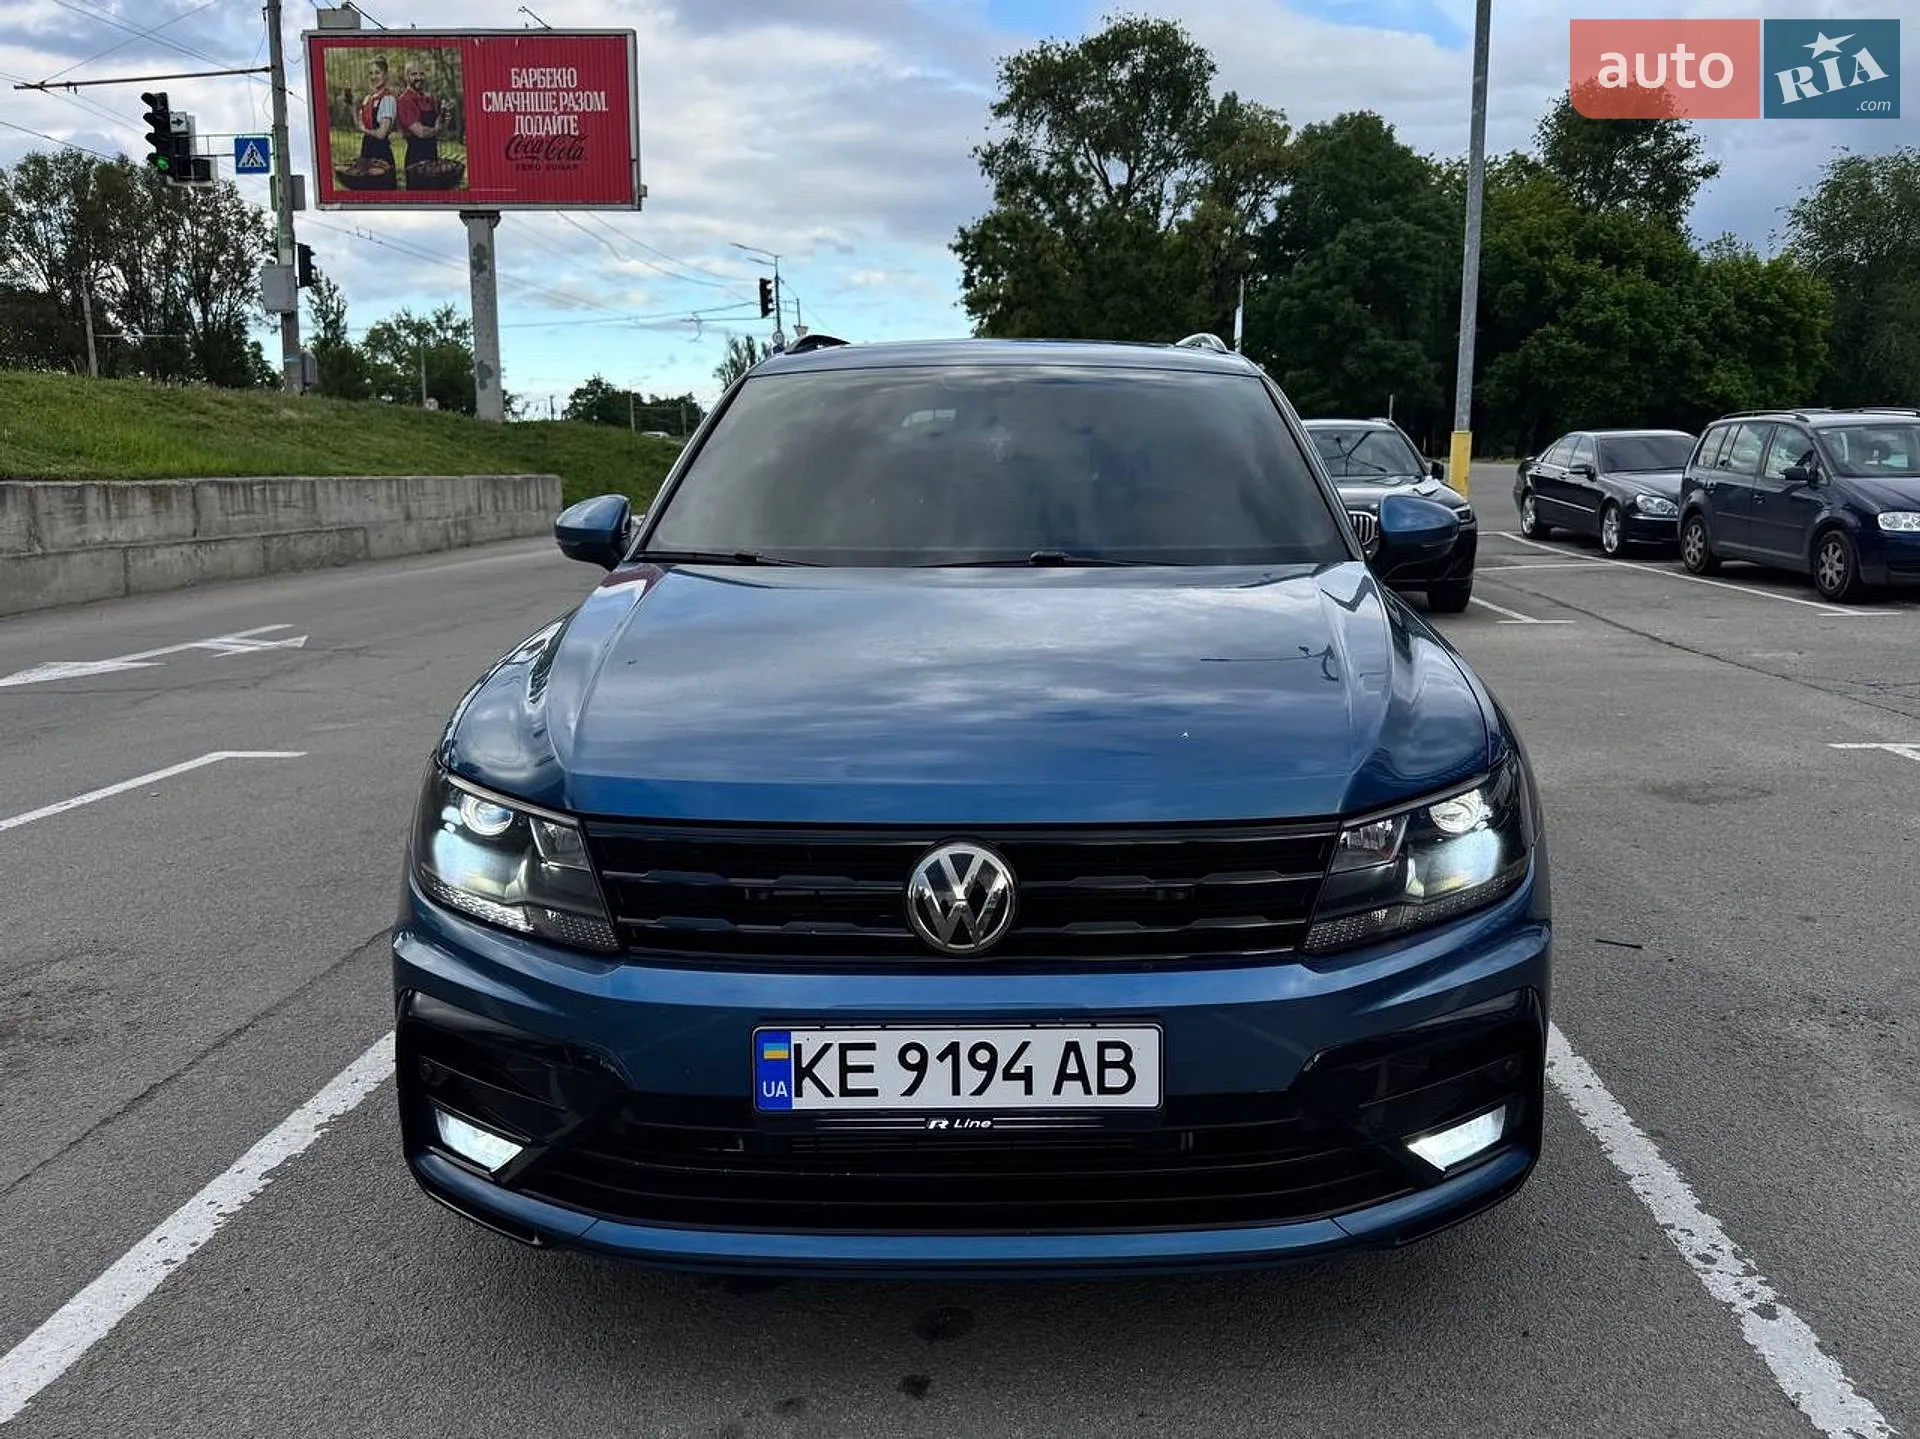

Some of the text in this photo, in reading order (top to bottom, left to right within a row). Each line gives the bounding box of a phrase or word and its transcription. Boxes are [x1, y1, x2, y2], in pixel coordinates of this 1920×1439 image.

[511, 68, 577, 88] БАРБЕКЮ
[482, 91, 608, 112] СМАЧНІШЕ РАЗОМ.
[514, 112, 579, 138] ДОДАЙТЕ
[793, 1041, 1136, 1097] KE 9194 AB
[763, 1081, 788, 1097] UA
[954, 1119, 992, 1129] Line
